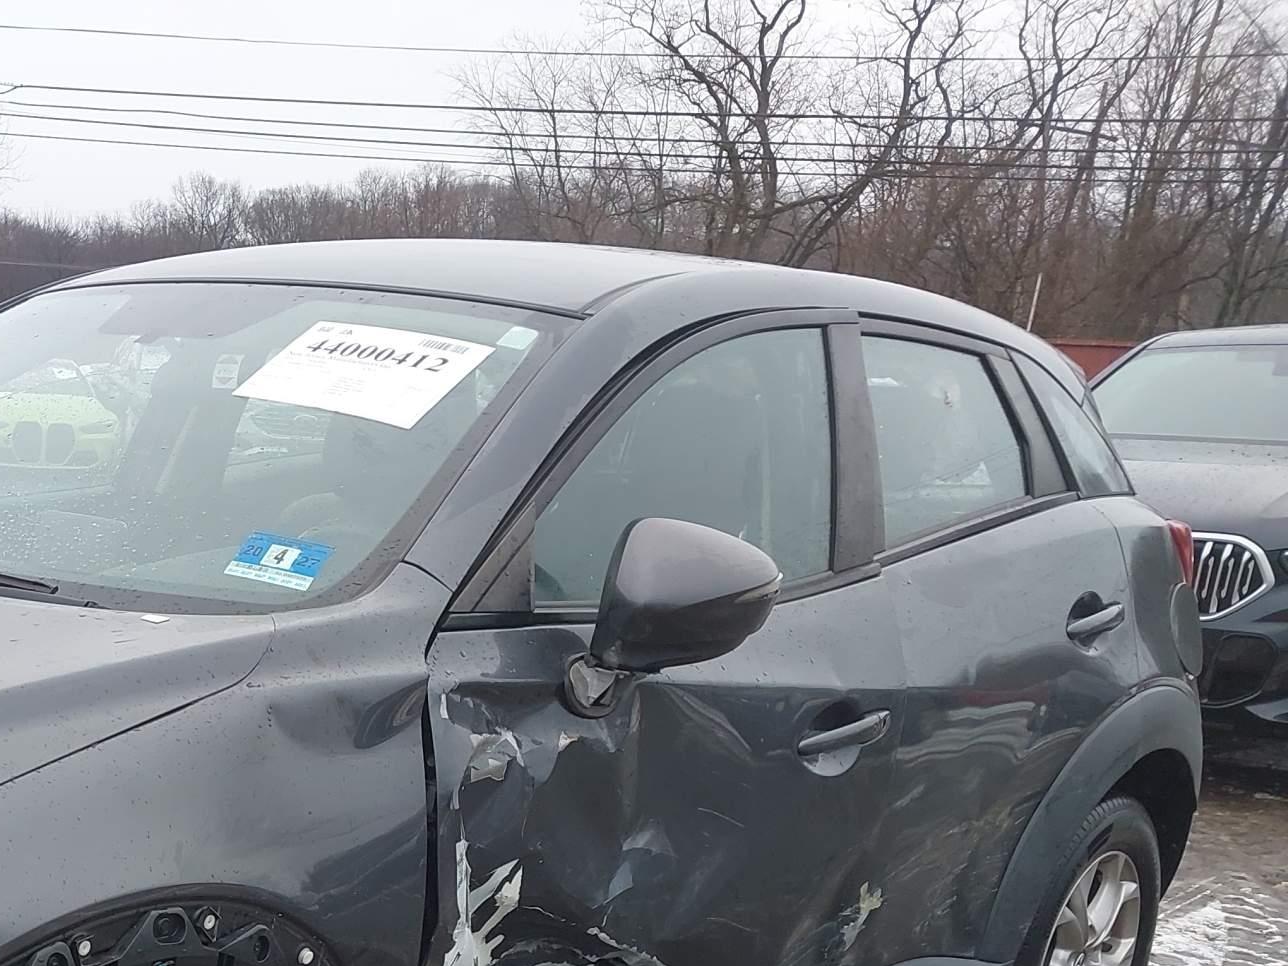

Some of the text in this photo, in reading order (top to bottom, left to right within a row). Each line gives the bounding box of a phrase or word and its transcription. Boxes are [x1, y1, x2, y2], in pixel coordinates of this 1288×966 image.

[307, 340, 448, 372] 44000412
[243, 544, 320, 568] 20 4 27
